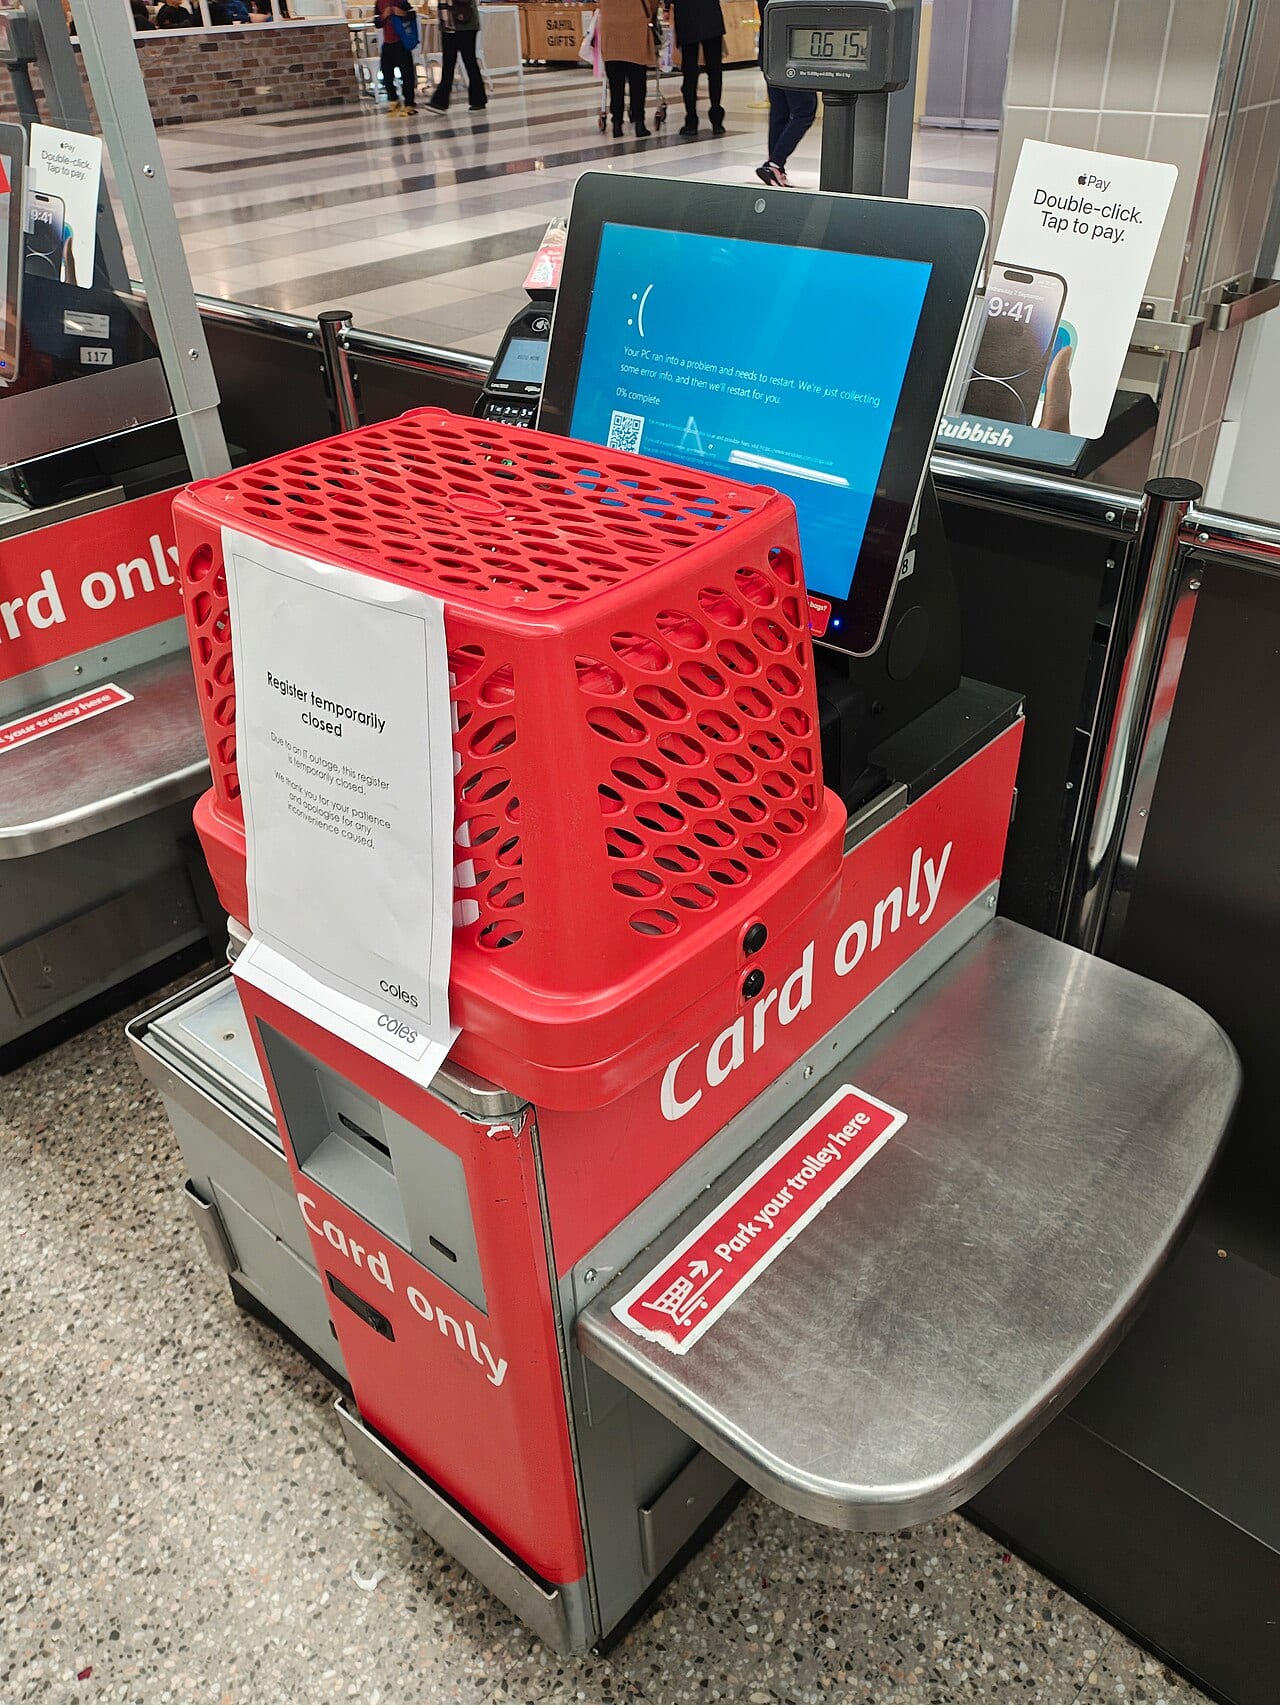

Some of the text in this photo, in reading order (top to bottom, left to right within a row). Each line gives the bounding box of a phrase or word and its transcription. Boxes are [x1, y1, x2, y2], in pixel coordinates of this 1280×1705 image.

[547, 36, 576, 46] GIFTS
[46, 161, 60, 174] Tap
[61, 166, 70, 176] to
[1087, 175, 1111, 192] Pay
[1033, 188, 1143, 224] Double-click.
[1041, 210, 1125, 244] Tap to pay.
[988, 297, 1034, 324] 9:41
[88, 351, 108, 362] 117
[620, 364, 640, 375] some
[640, 367, 658, 378] error
[675, 374, 690, 386] and
[690, 376, 708, 389] then
[726, 384, 751, 399] restart
[752, 388, 764, 401] for
[624, 346, 640, 357] Your
[641, 349, 652, 360] PC
[652, 353, 664, 362] ran
[665, 354, 679, 365] into
[680, 359, 686, 367] a
[686, 359, 717, 374] problem
[718, 365, 734, 376] and
[735, 369, 757, 381] needs
[759, 373, 768, 383] to
[798, 379, 822, 394] We're
[822, 386, 838, 398] just
[840, 389, 881, 408] collecting
[615, 387, 661, 406] 0% complete
[938, 418, 1014, 448] Rubbish
[0, 569, 67, 640] rd
[4, 725, 36, 742] your
[36, 706, 81, 728] trolley
[78, 694, 112, 711] here
[267, 671, 386, 734] Register temporarily
[301, 711, 342, 738] closed
[270, 731, 390, 791] Due to an IT outage, this register
[294, 756, 334, 785] temporarily
[336, 776, 366, 796] closed.
[274, 769, 392, 829] We thank you for your patience
[289, 792, 373, 836] and apologise for any
[288, 800, 376, 850] inconvenience caused.
[379, 980, 418, 1008] coles
[660, 840, 953, 1121] Card only
[377, 1014, 418, 1044] coles
[714, 1111, 872, 1263] Park your trolley here
[297, 1192, 508, 1387] Card only
